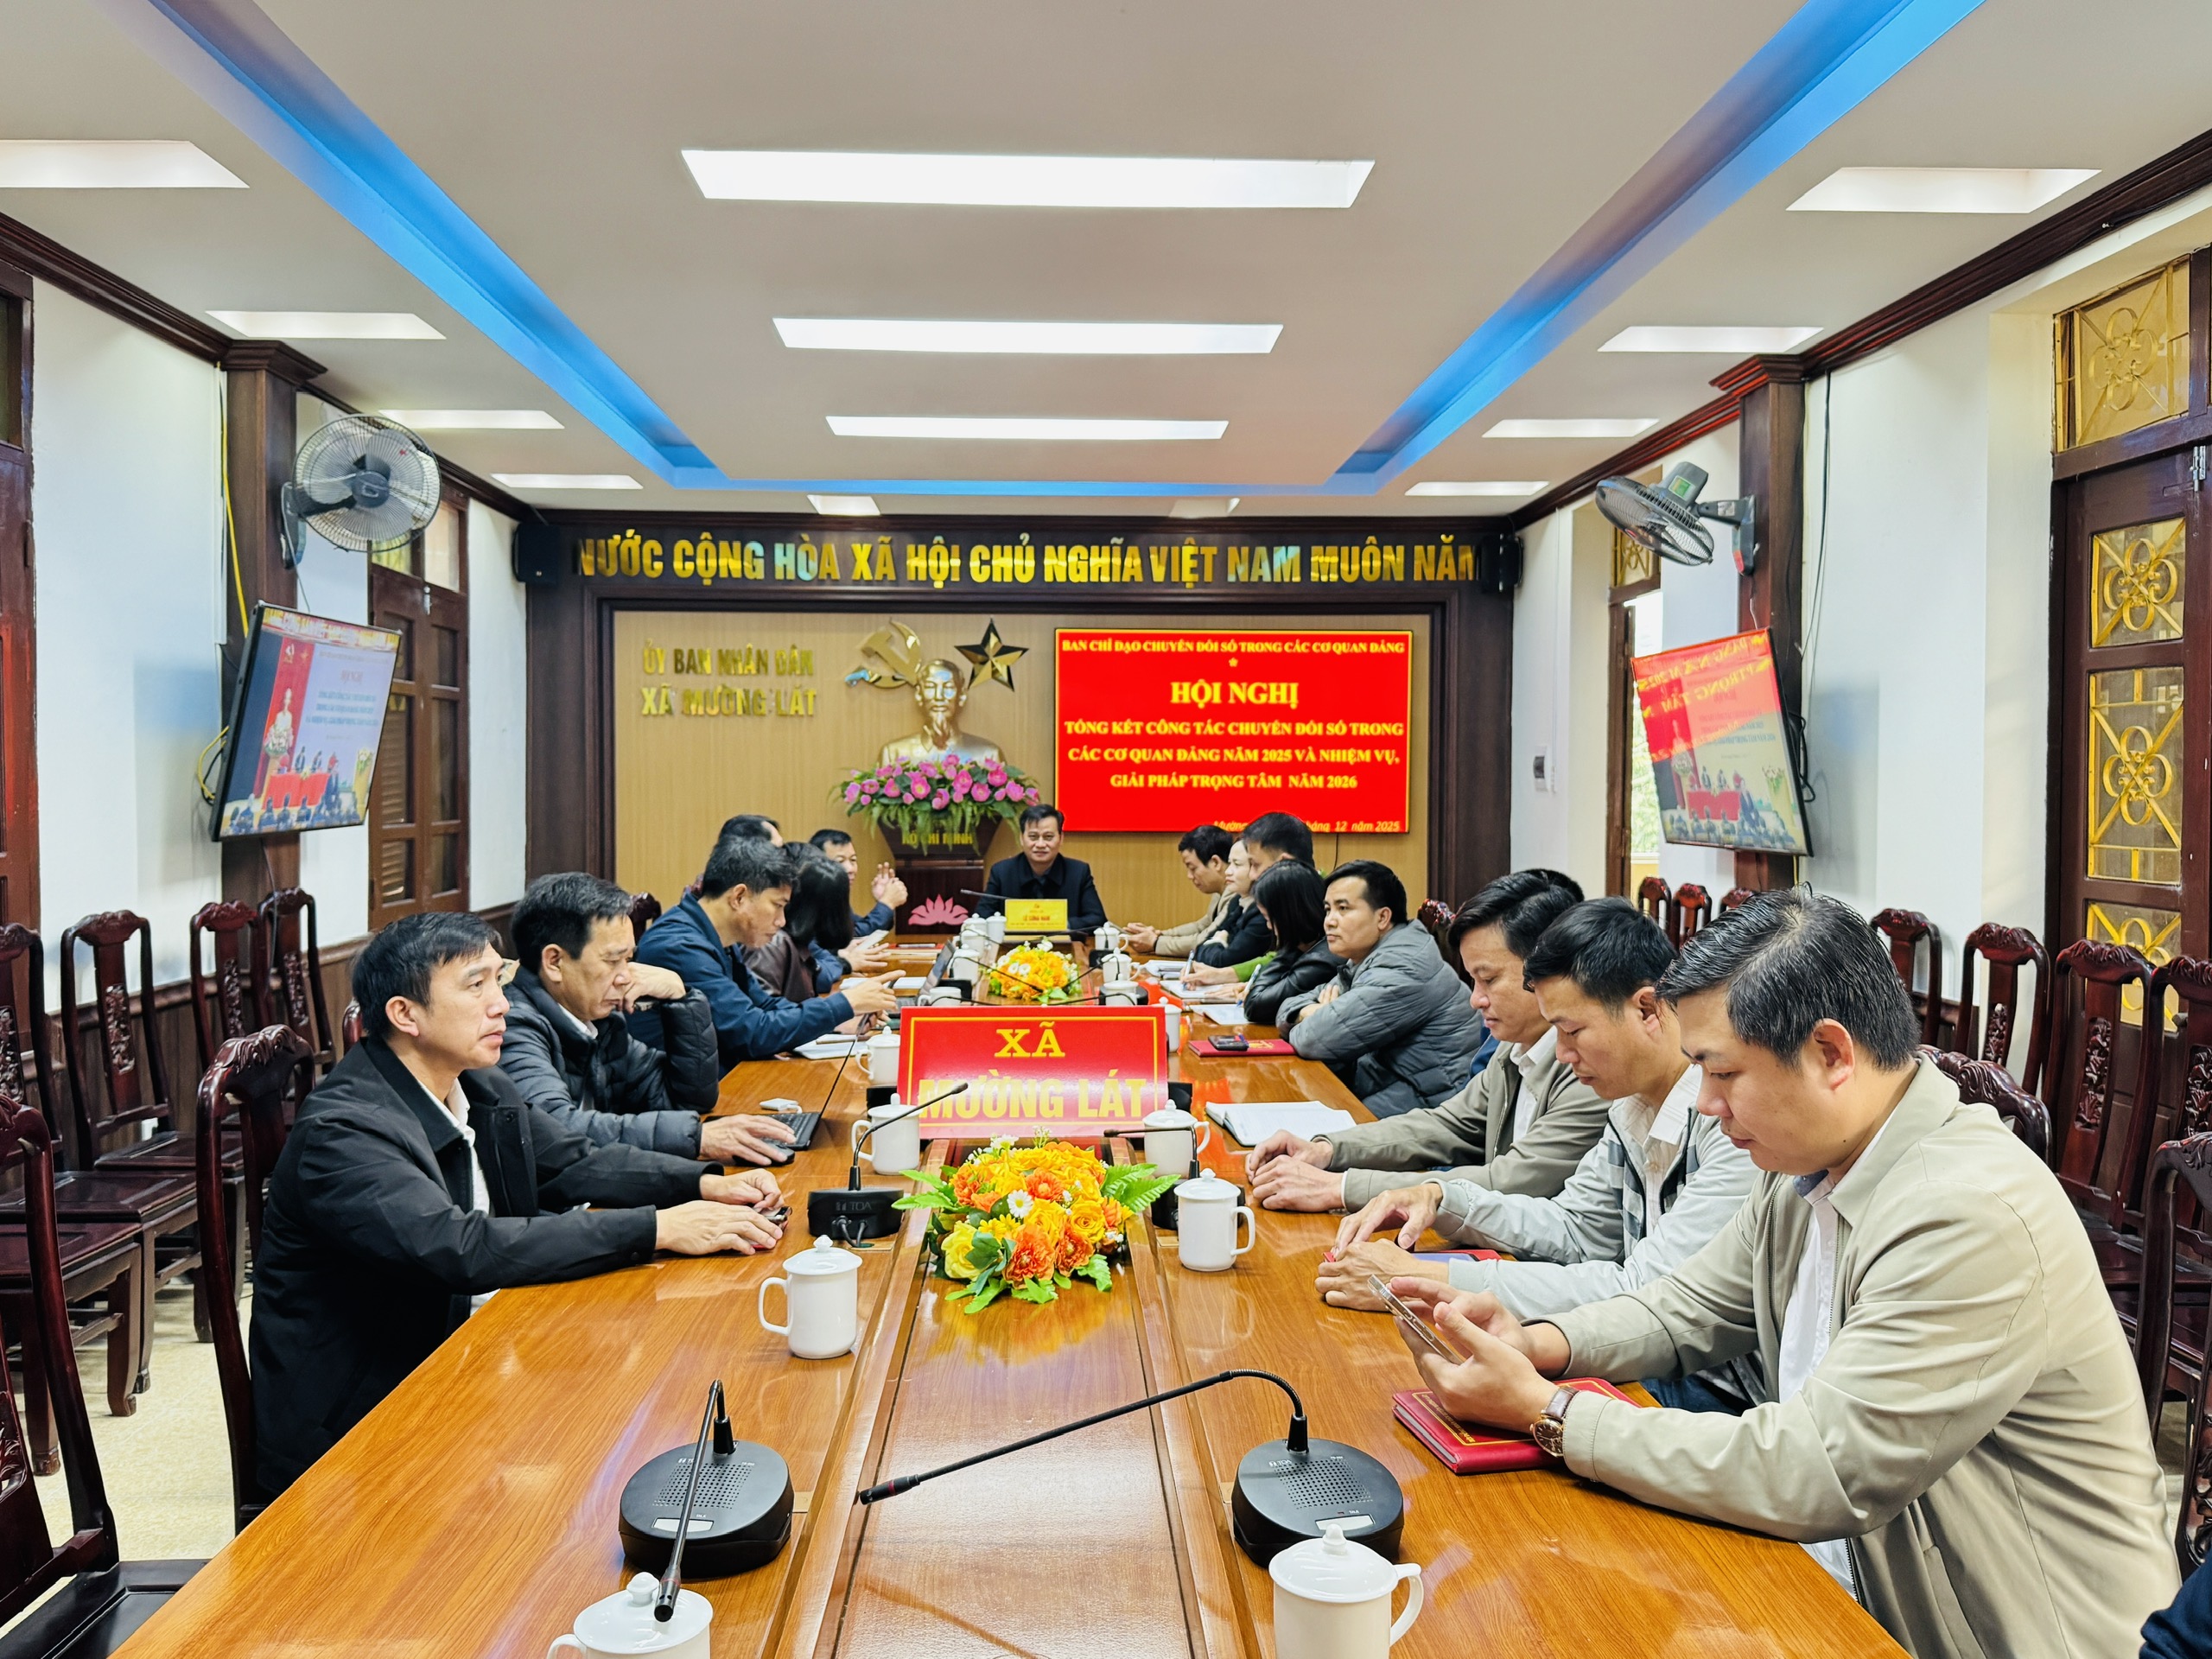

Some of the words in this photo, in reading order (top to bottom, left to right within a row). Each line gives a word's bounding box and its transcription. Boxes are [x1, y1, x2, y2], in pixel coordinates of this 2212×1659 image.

[578, 529, 664, 577] NƯỚC
[673, 531, 765, 586] CỘNG
[775, 533, 840, 581] HÒA
[850, 536, 896, 581] XÃ
[906, 536, 961, 588] HỘI
[969, 532, 1035, 583] CHỦ
[1044, 537, 1143, 582] NGHĨA
[1149, 537, 1217, 588] VIỆT
[1227, 545, 1301, 583] NAM
[1310, 536, 1404, 582] MUÔN
[673, 648, 712, 675] BAN
[717, 643, 768, 676] NHÂN
[775, 643, 813, 676] DÂN
[1062, 639, 1087, 652] BAN
[1239, 642, 1282, 653] TRONG
[1284, 639, 1311, 653] CÁC
[1332, 641, 1367, 655] QUAN
[642, 683, 674, 715] XÃ
[1171, 678, 1222, 709] HỘI
[1228, 682, 1299, 710] NGHỊ
[1146, 718, 1191, 735] CÔNG
[1193, 719, 1225, 735] TÁC
[1349, 722, 1404, 736] TRONG
[1068, 745, 1101, 761] CÁC
[1103, 747, 1128, 761] CƠ
[1129, 747, 1173, 764] QUAN
[1176, 746, 1221, 762] ĐẢNG
[1224, 747, 1259, 762] NĂM
[1262, 748, 1293, 762] 2025
[1294, 746, 1317, 762] VÀ
[1319, 747, 1371, 766] NHIỆM
[1374, 749, 1401, 766] VỤ,
[1110, 772, 1144, 788] GIẢI
[1147, 772, 1189, 788] PHÁP
[1190, 774, 1244, 791] TRỌNG
[1247, 772, 1282, 788] TÂM
[1288, 772, 1324, 788] NĂM
[1326, 775, 1358, 789] 2026
[1335, 821, 1348, 832] 12
[1351, 821, 1374, 831] năm
[1375, 821, 1400, 832] 2025
[995, 1021, 1065, 1058] XÃ
[918, 1070, 1065, 1119] MƯỜNG
[1078, 1070, 1147, 1118] LÁT
[849, 1201, 872, 1211] TOA
